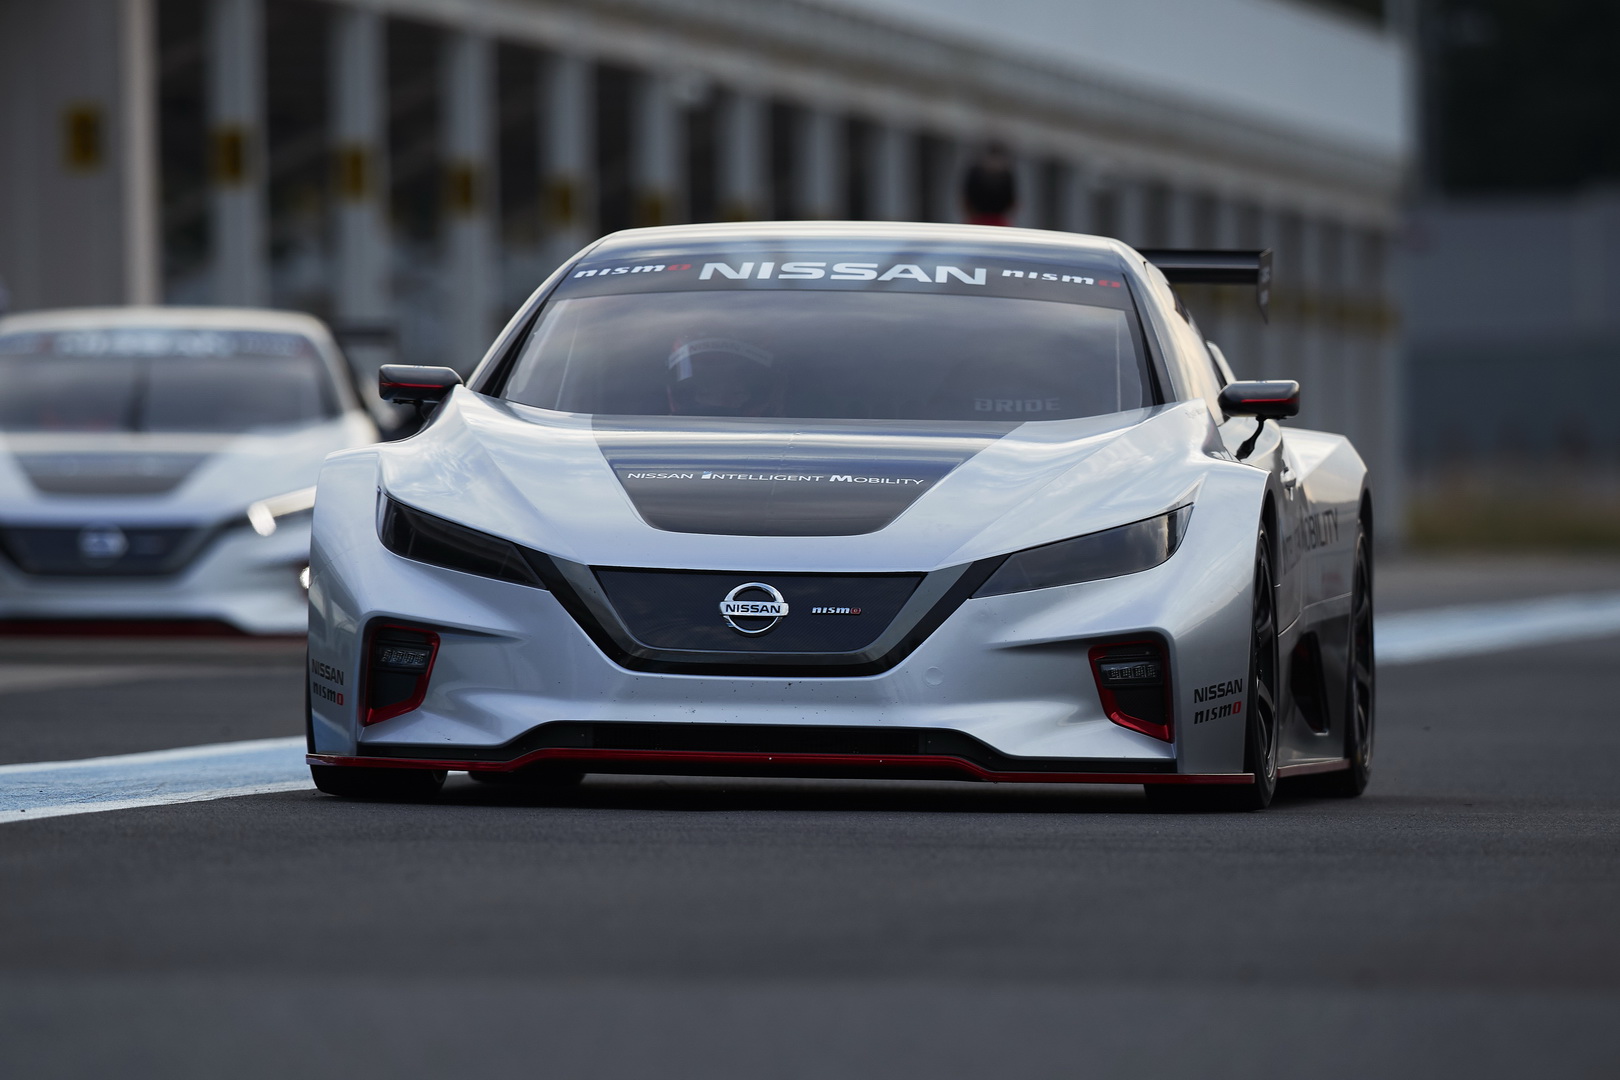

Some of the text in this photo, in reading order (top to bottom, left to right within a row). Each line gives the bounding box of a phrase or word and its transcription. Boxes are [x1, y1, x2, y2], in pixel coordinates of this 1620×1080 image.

[698, 261, 988, 286] NISSAN
[974, 397, 1060, 412] BRIDE
[627, 472, 694, 480] NISSAN
[829, 474, 924, 485] MOBILITY
[725, 604, 781, 614] NISSAN
[311, 658, 344, 686] NISSAN
[1194, 678, 1243, 704] NISSAN
